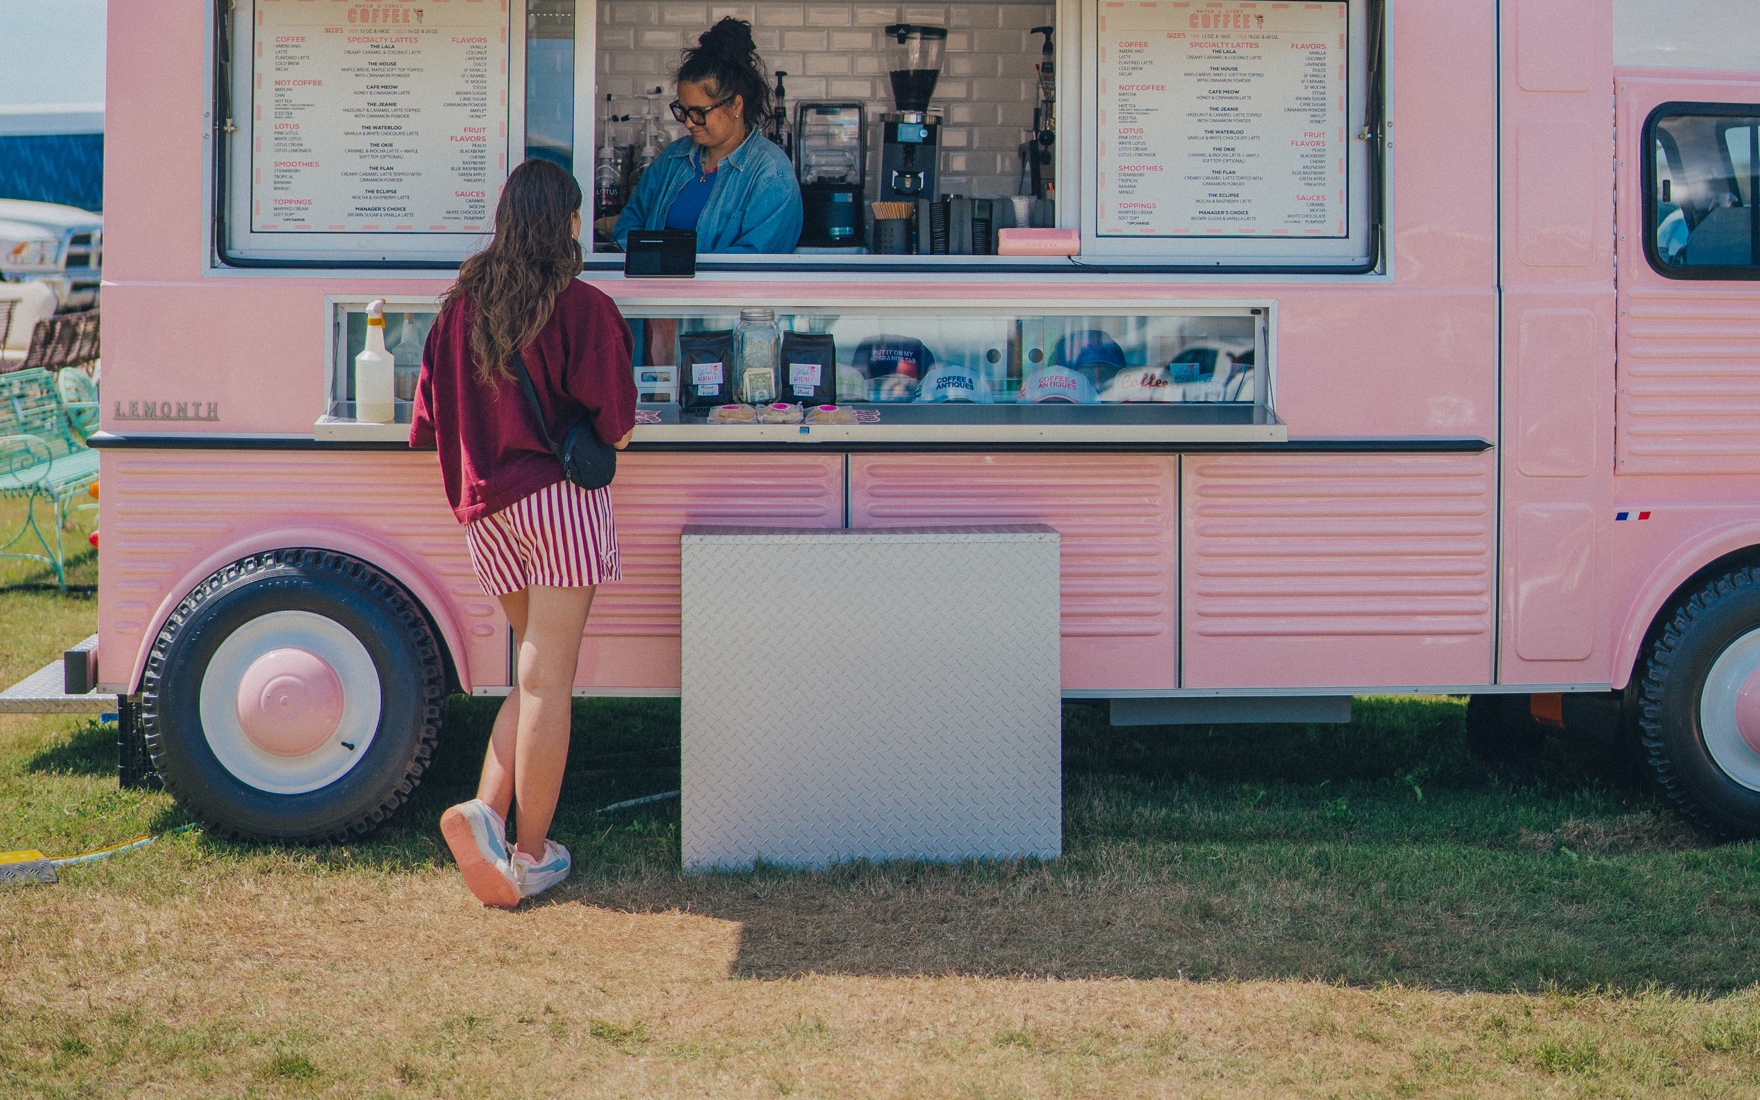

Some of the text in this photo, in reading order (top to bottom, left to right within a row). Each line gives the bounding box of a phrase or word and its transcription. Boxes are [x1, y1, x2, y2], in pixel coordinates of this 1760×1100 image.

[347, 8, 411, 24] COFFEE
[1189, 13, 1251, 29] COFFEE
[903, 350, 914, 358] MY
[936, 375, 967, 384] COFFEE
[1038, 376, 1069, 384] COFFEE
[1121, 372, 1169, 391] Coffee
[935, 381, 975, 391] ANTIQUES
[1037, 381, 1077, 391] ANTIQUES
[114, 399, 219, 419] LEMONTH
